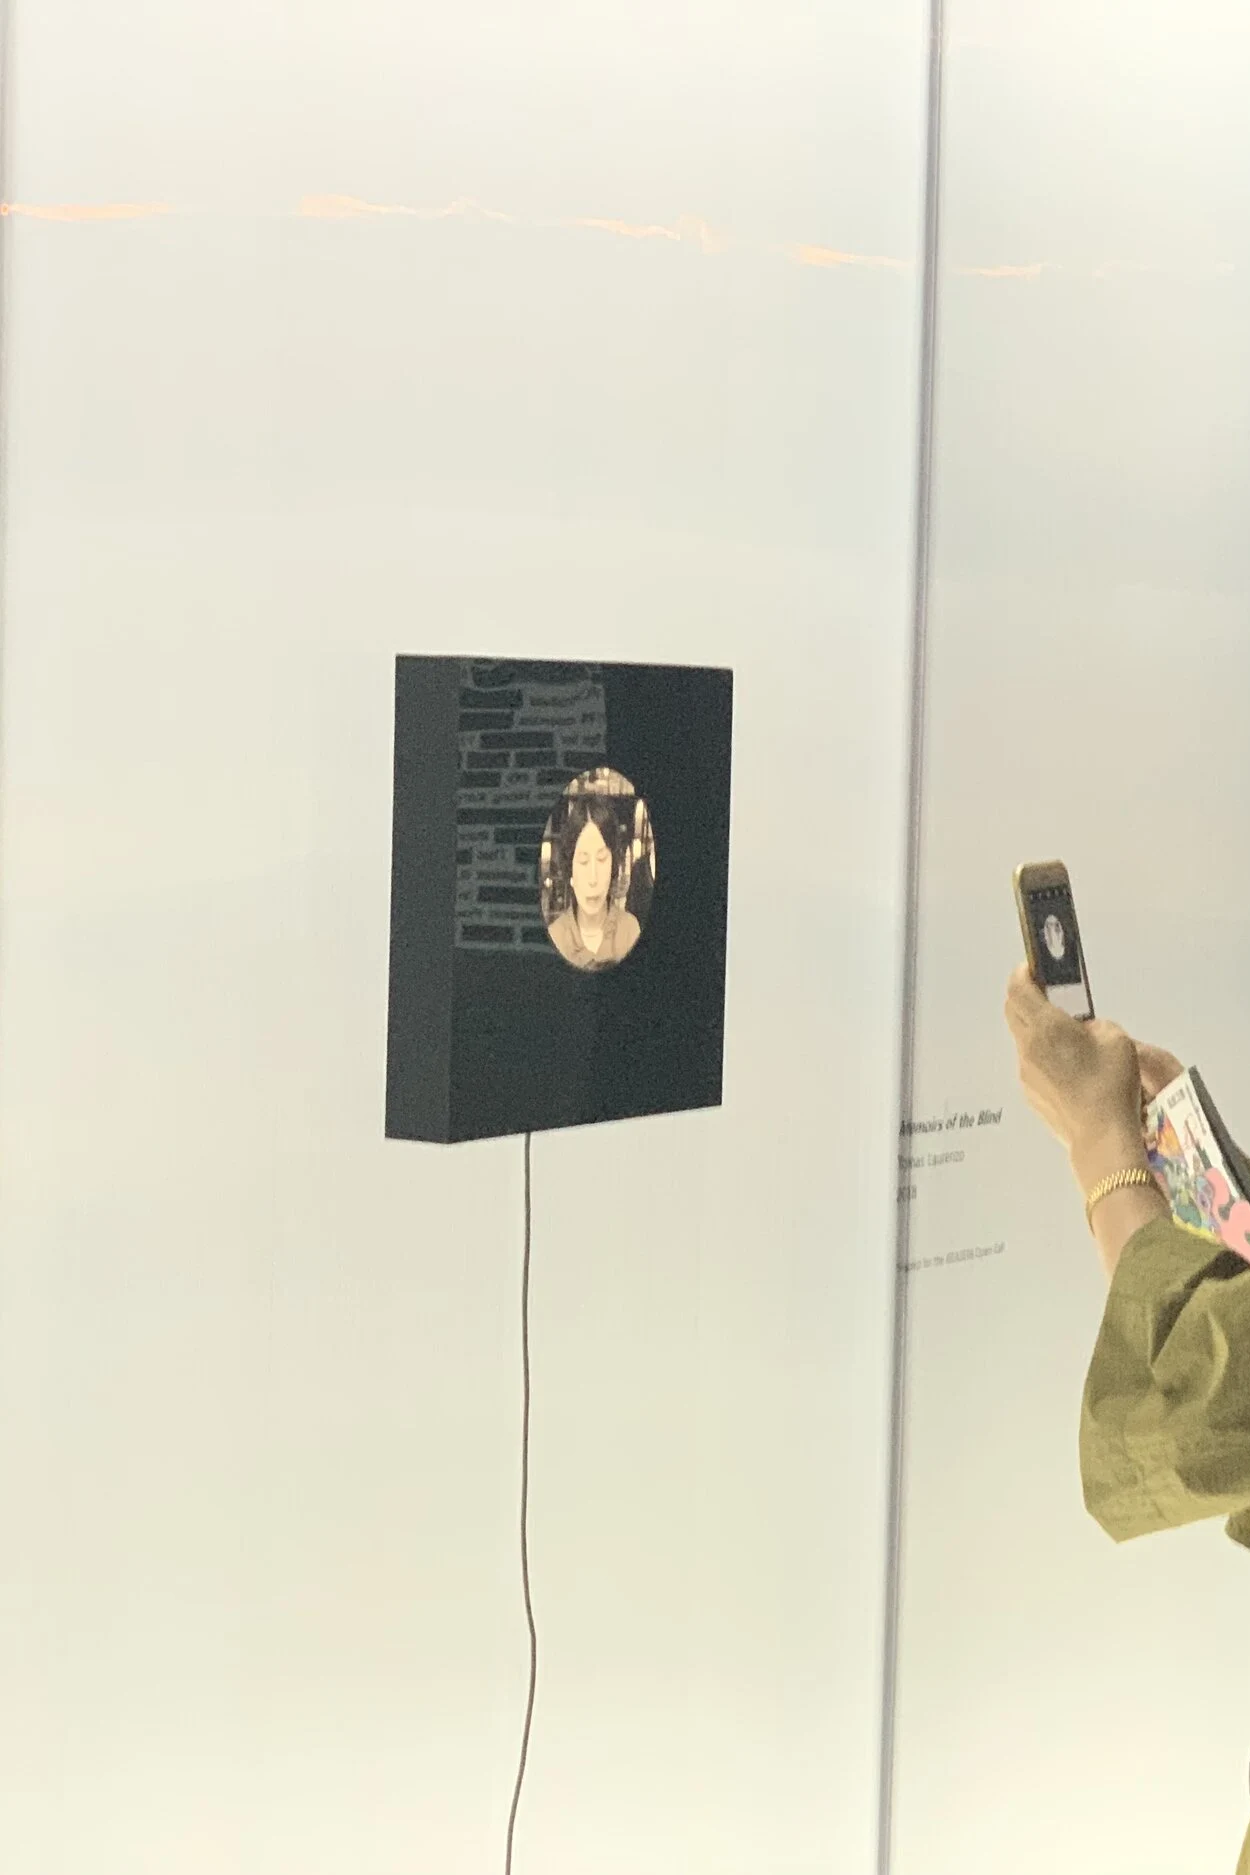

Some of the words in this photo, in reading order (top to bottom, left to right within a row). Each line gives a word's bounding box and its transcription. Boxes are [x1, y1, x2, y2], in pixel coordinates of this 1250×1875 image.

[946, 1113, 958, 1130] of
[959, 1111, 975, 1129] the
[977, 1107, 1004, 1126] Blind
